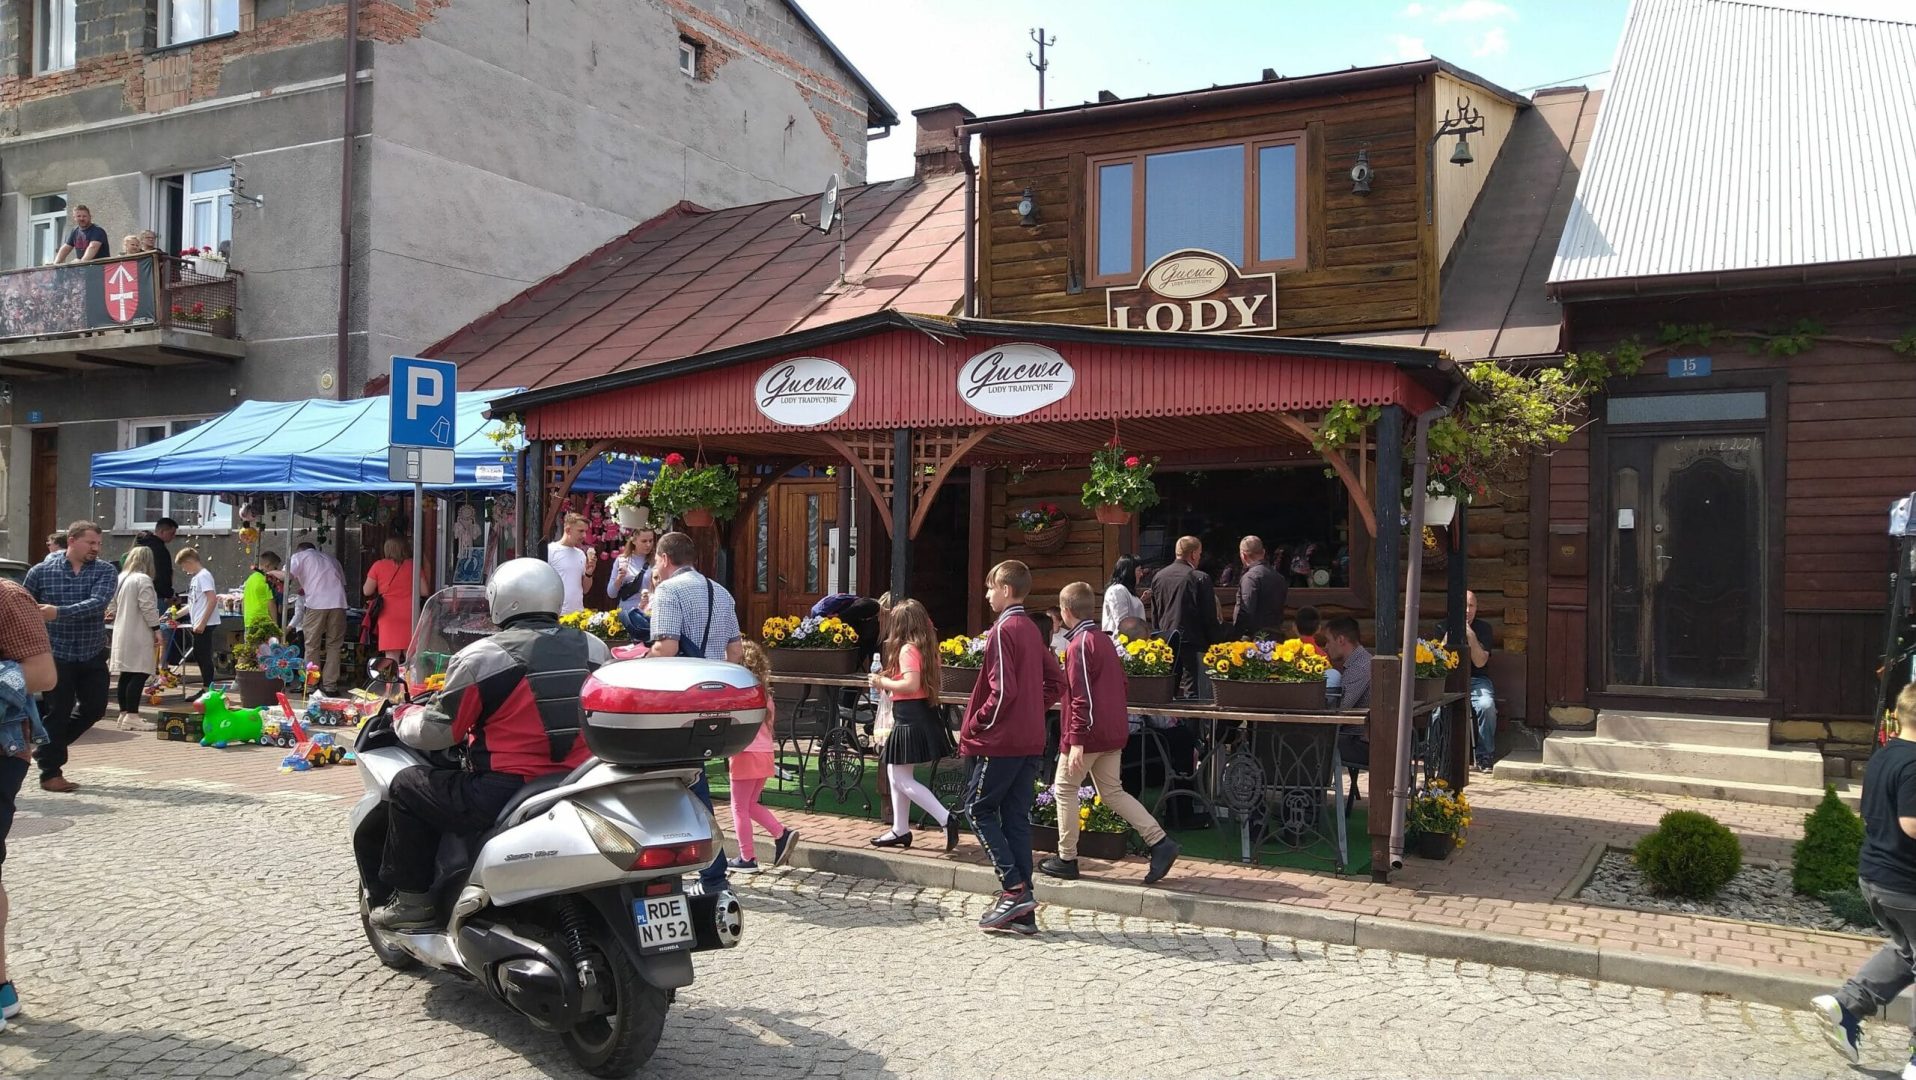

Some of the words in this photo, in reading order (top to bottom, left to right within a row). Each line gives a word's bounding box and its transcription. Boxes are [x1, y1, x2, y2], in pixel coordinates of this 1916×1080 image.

[1159, 262, 1215, 289] Gucwa
[1114, 294, 1268, 332] LODY
[964, 351, 1064, 398] Gucwa
[1682, 358, 1697, 371] 15
[406, 366, 443, 420] P
[761, 364, 847, 407] Gucwa
[988, 385, 1006, 394] LODY
[1008, 383, 1053, 393] TRADYCYJNE
[781, 396, 797, 404] LODY
[798, 395, 837, 404] TRADYCYJNE
[636, 915, 647, 923] PL
[647, 900, 682, 920] RDE
[642, 920, 690, 943] NY52
[658, 944, 680, 952] HONDA
